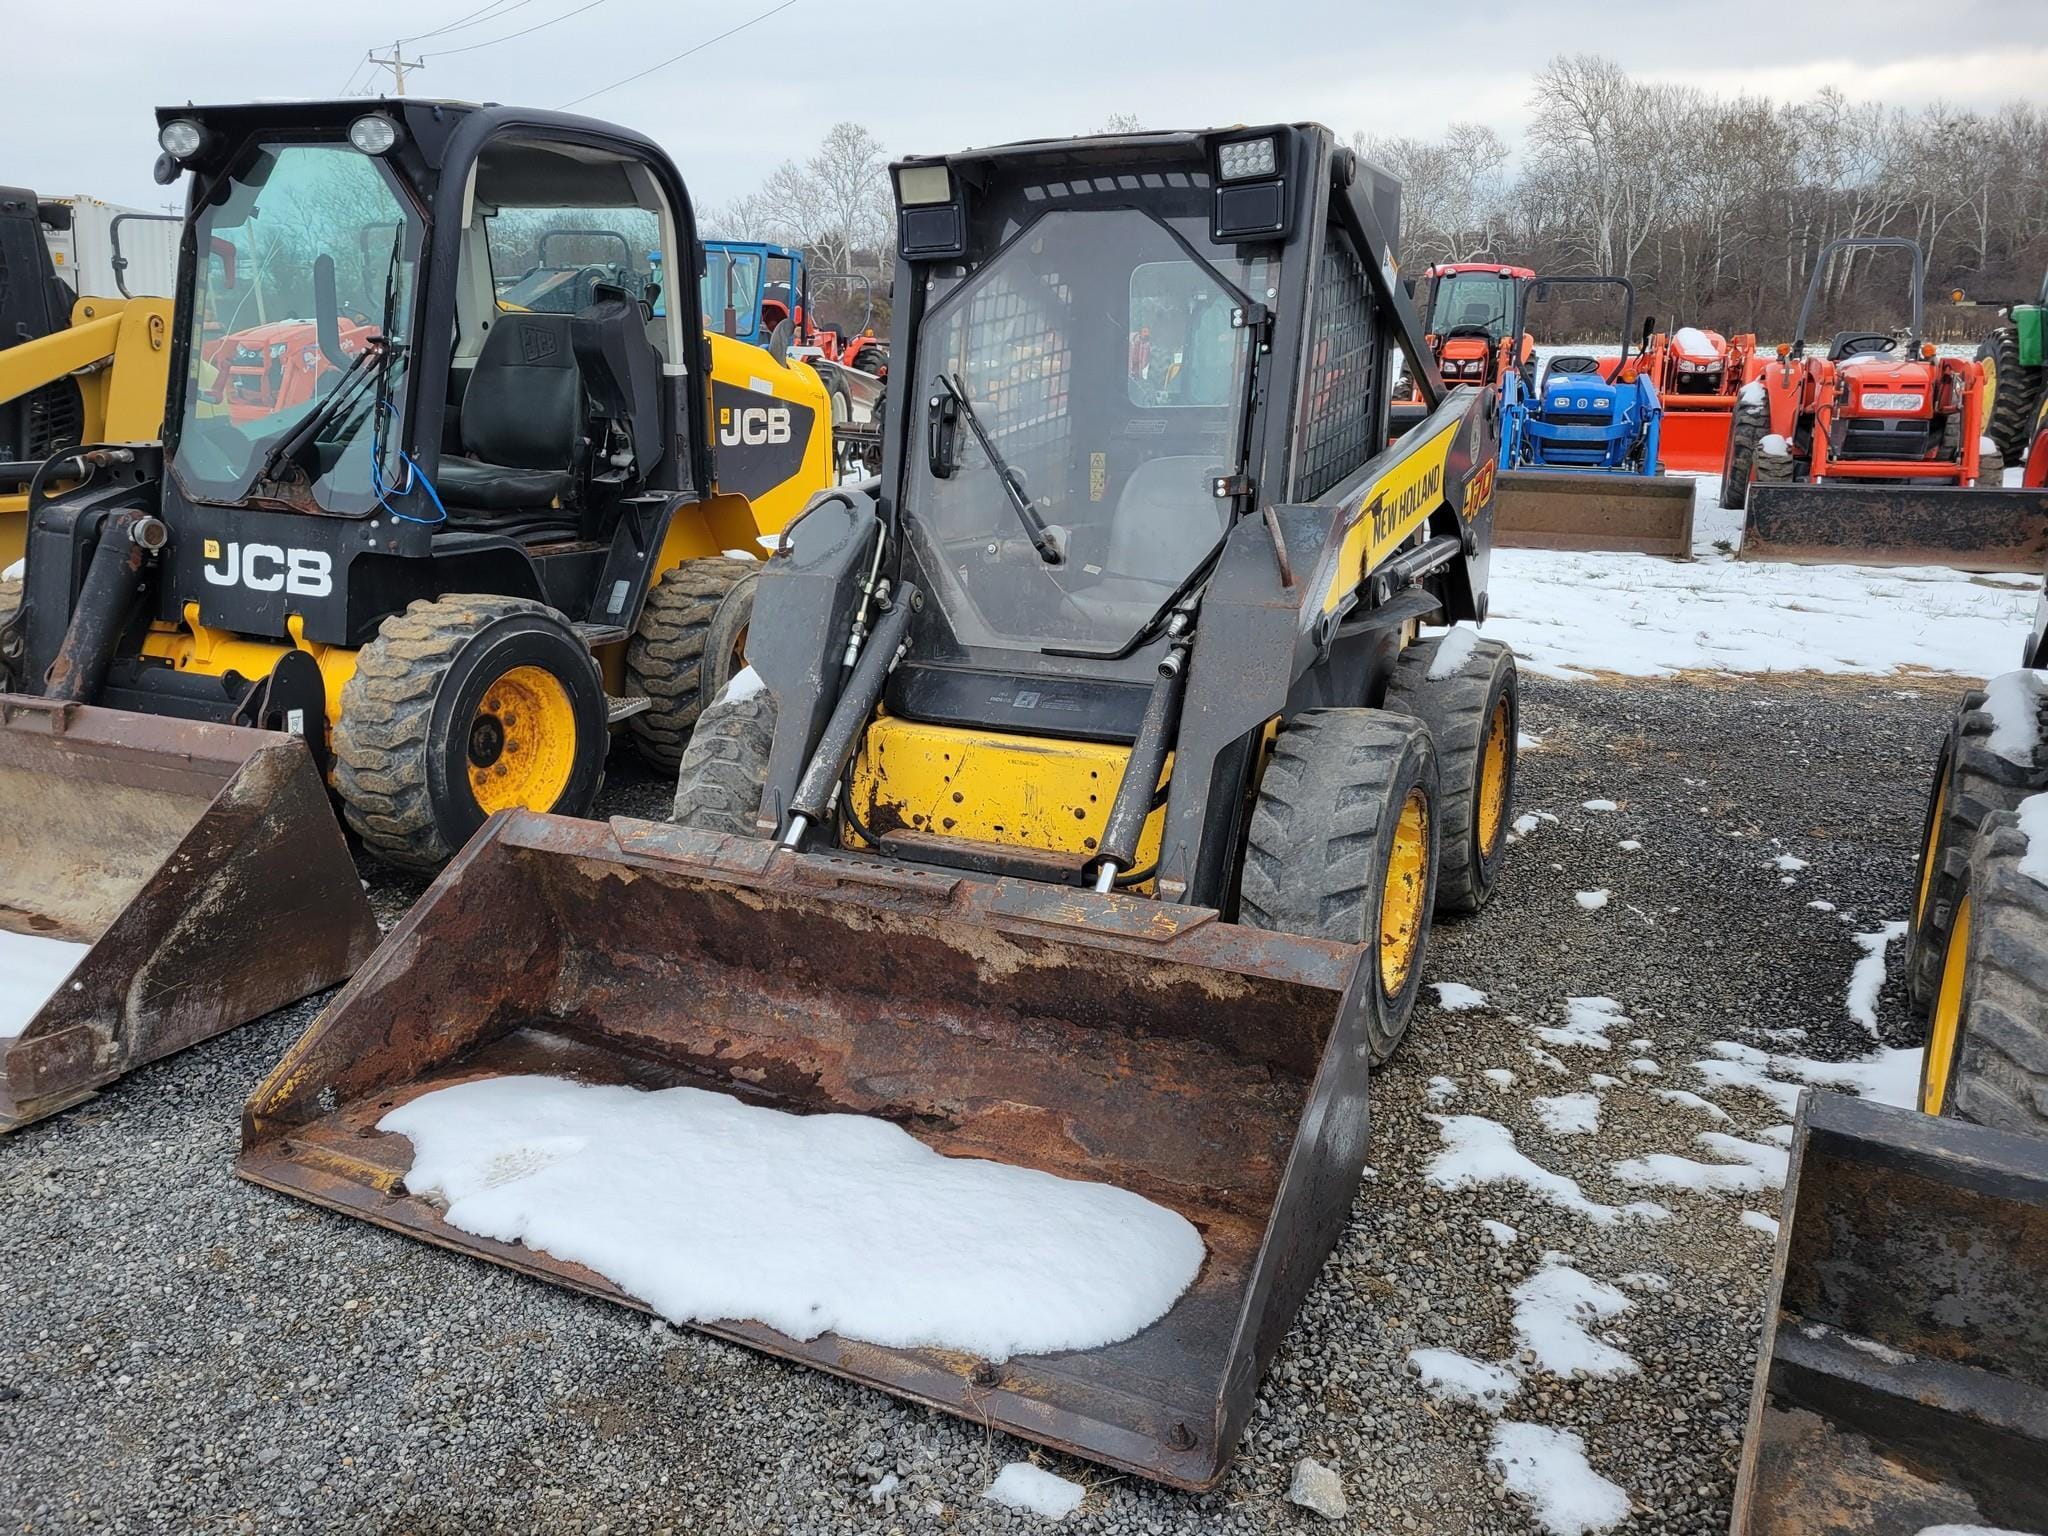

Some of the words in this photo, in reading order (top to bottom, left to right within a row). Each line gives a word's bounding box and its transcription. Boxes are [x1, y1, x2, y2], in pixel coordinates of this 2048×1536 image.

[720, 408, 791, 446] JCB
[1373, 497, 1397, 548] NEW
[1399, 464, 1440, 524] HOLLAND
[204, 542, 333, 597] JCB
